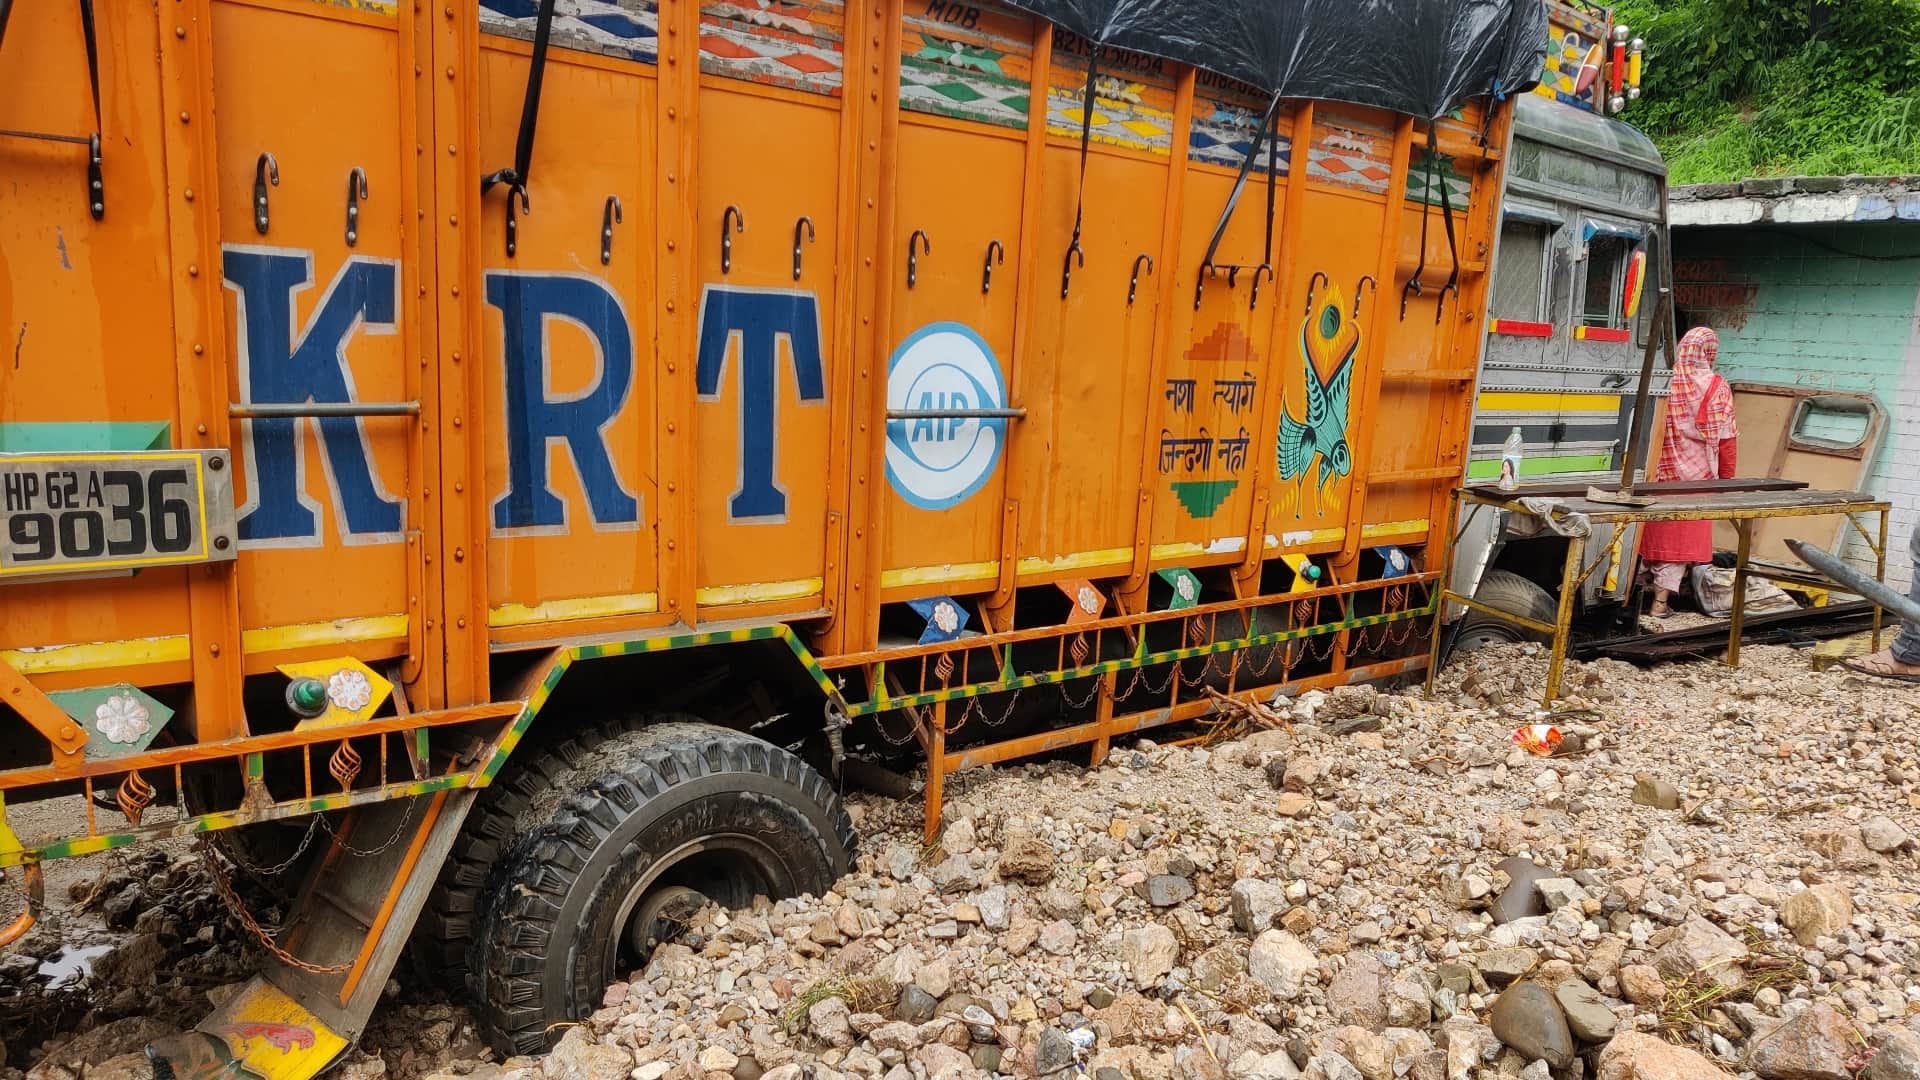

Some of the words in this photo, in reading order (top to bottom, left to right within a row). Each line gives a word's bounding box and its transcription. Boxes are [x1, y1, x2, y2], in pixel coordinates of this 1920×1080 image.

[911, 391, 969, 442] AIP
[1165, 379, 1197, 415] नशा
[1217, 426, 1251, 475] नहीं
